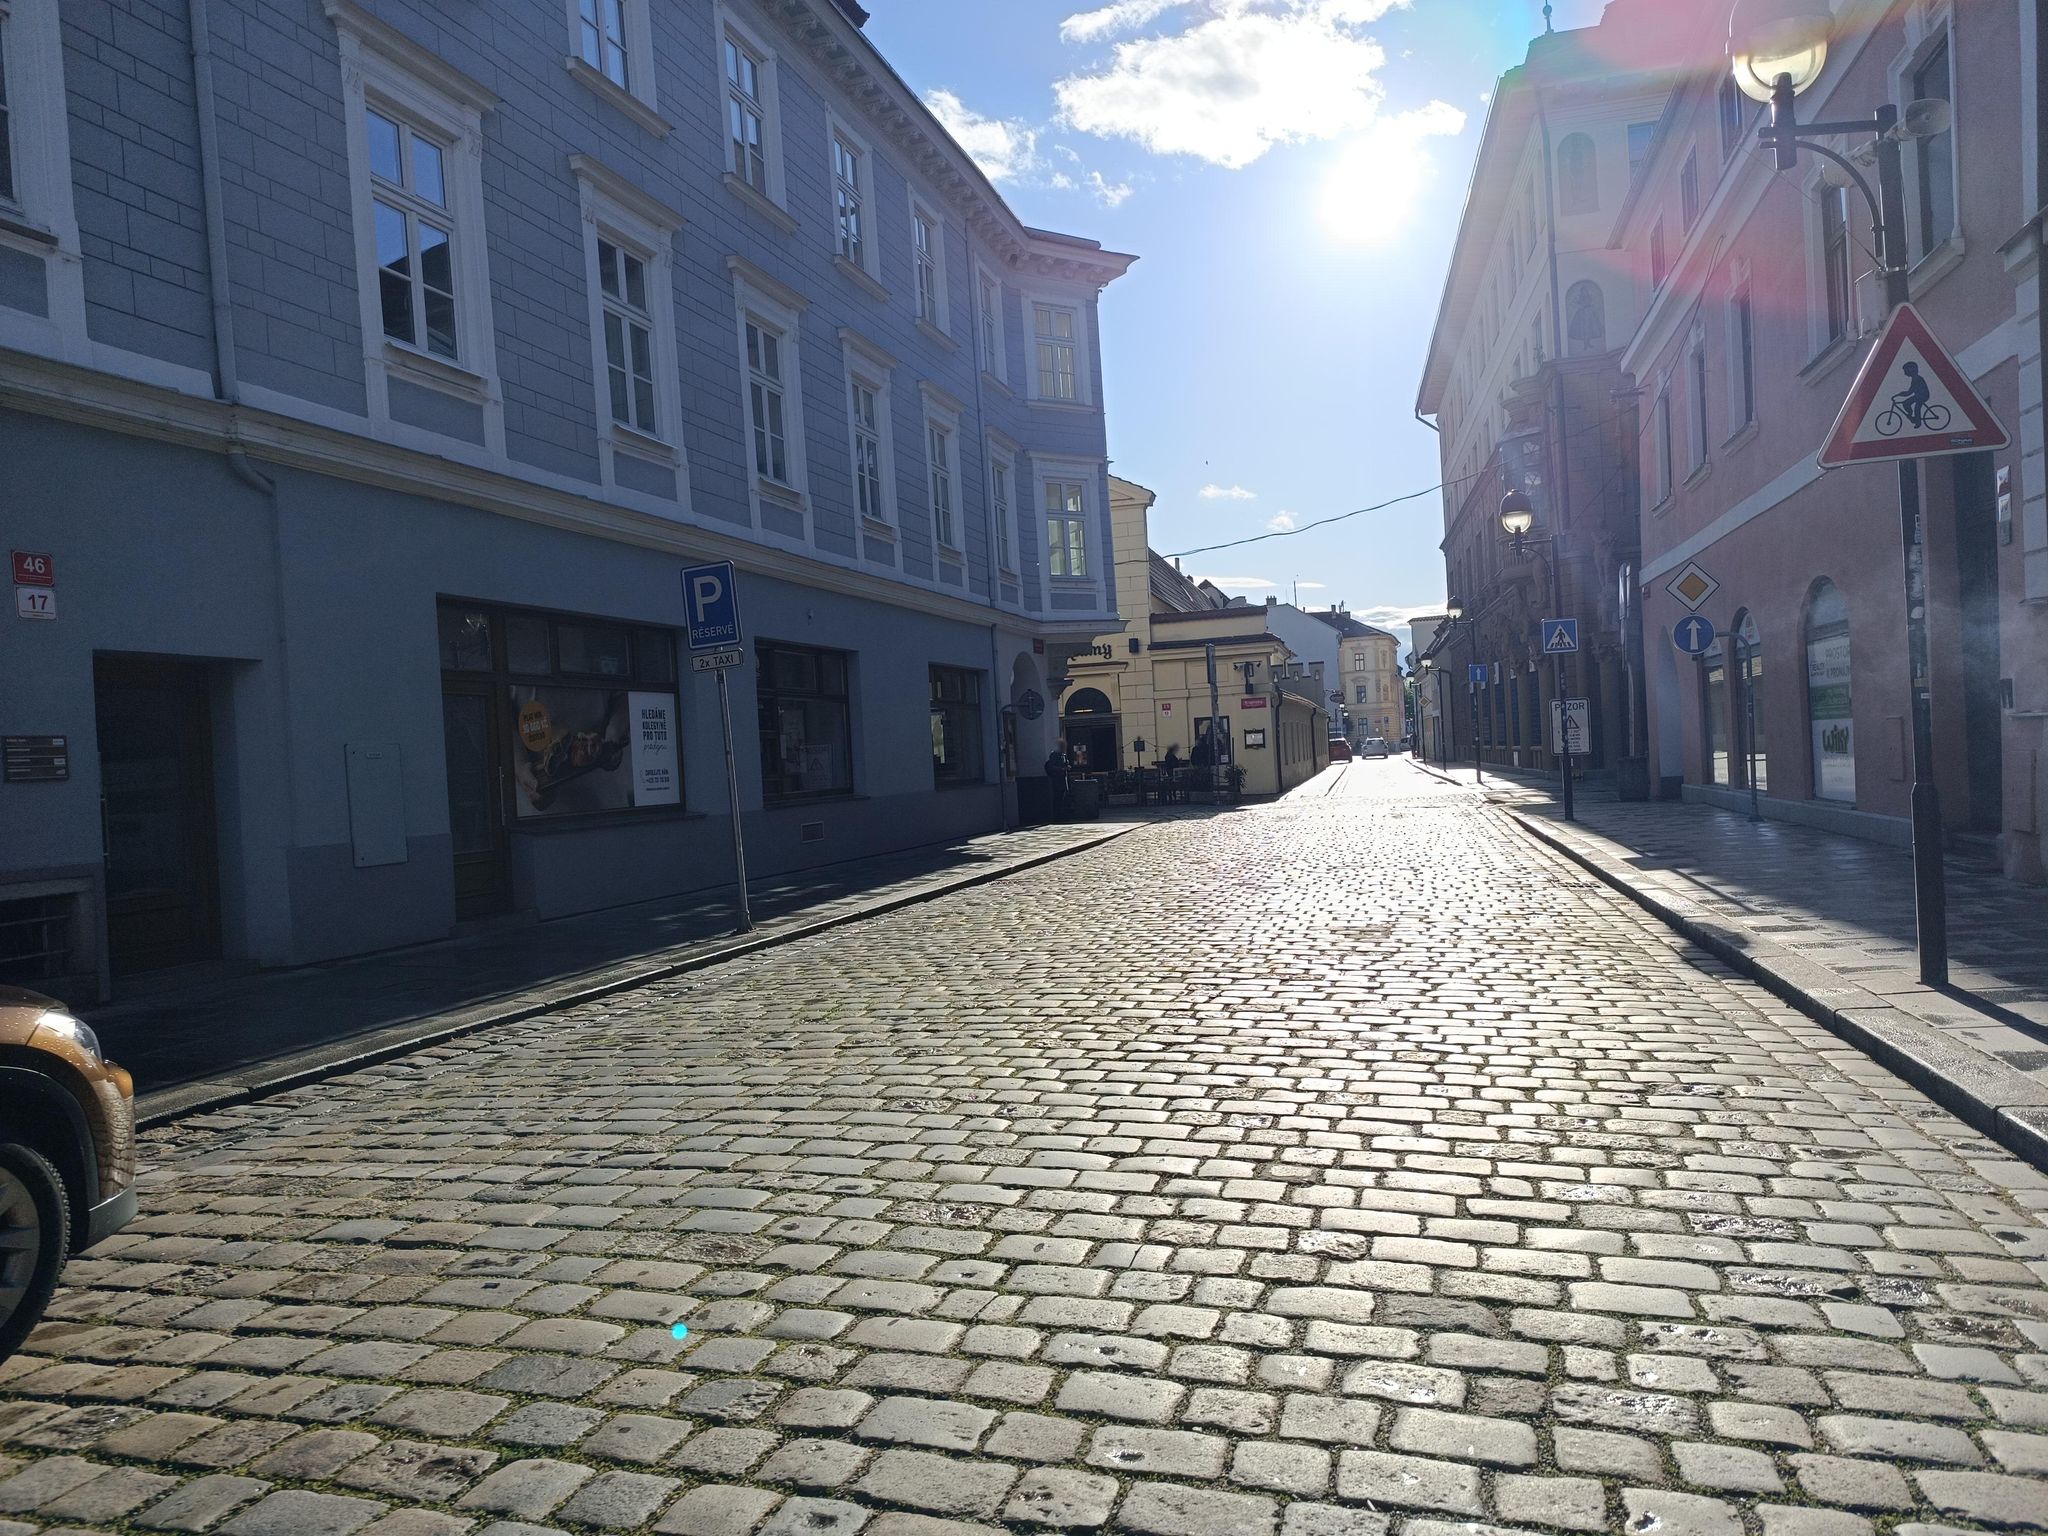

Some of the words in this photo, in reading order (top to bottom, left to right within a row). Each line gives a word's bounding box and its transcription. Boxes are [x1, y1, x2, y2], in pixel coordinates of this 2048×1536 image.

[24, 556, 45, 574] 46
[28, 594, 48, 610] 17
[693, 575, 723, 622] P
[713, 653, 734, 666] TAXI
[641, 707, 666, 719] HLEDÁME
[1555, 702, 1585, 711] PZOR
[643, 730, 654, 741] PRO
[654, 730, 667, 741] TUTO
